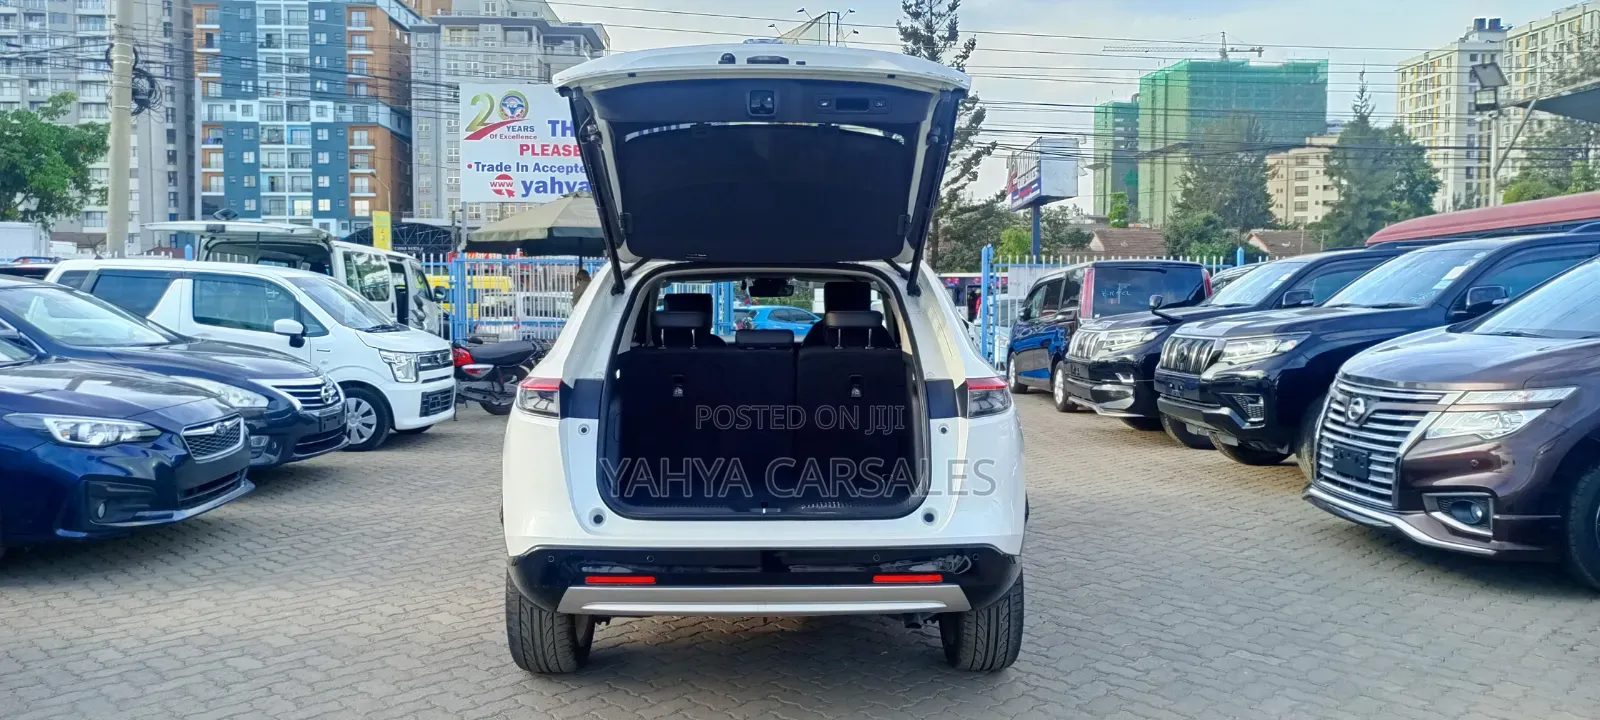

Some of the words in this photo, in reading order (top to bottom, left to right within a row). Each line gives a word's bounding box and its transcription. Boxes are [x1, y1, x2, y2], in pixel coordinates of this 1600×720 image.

[465, 90, 529, 132] 20
[474, 162, 512, 172] Trade
[516, 162, 528, 172] In
